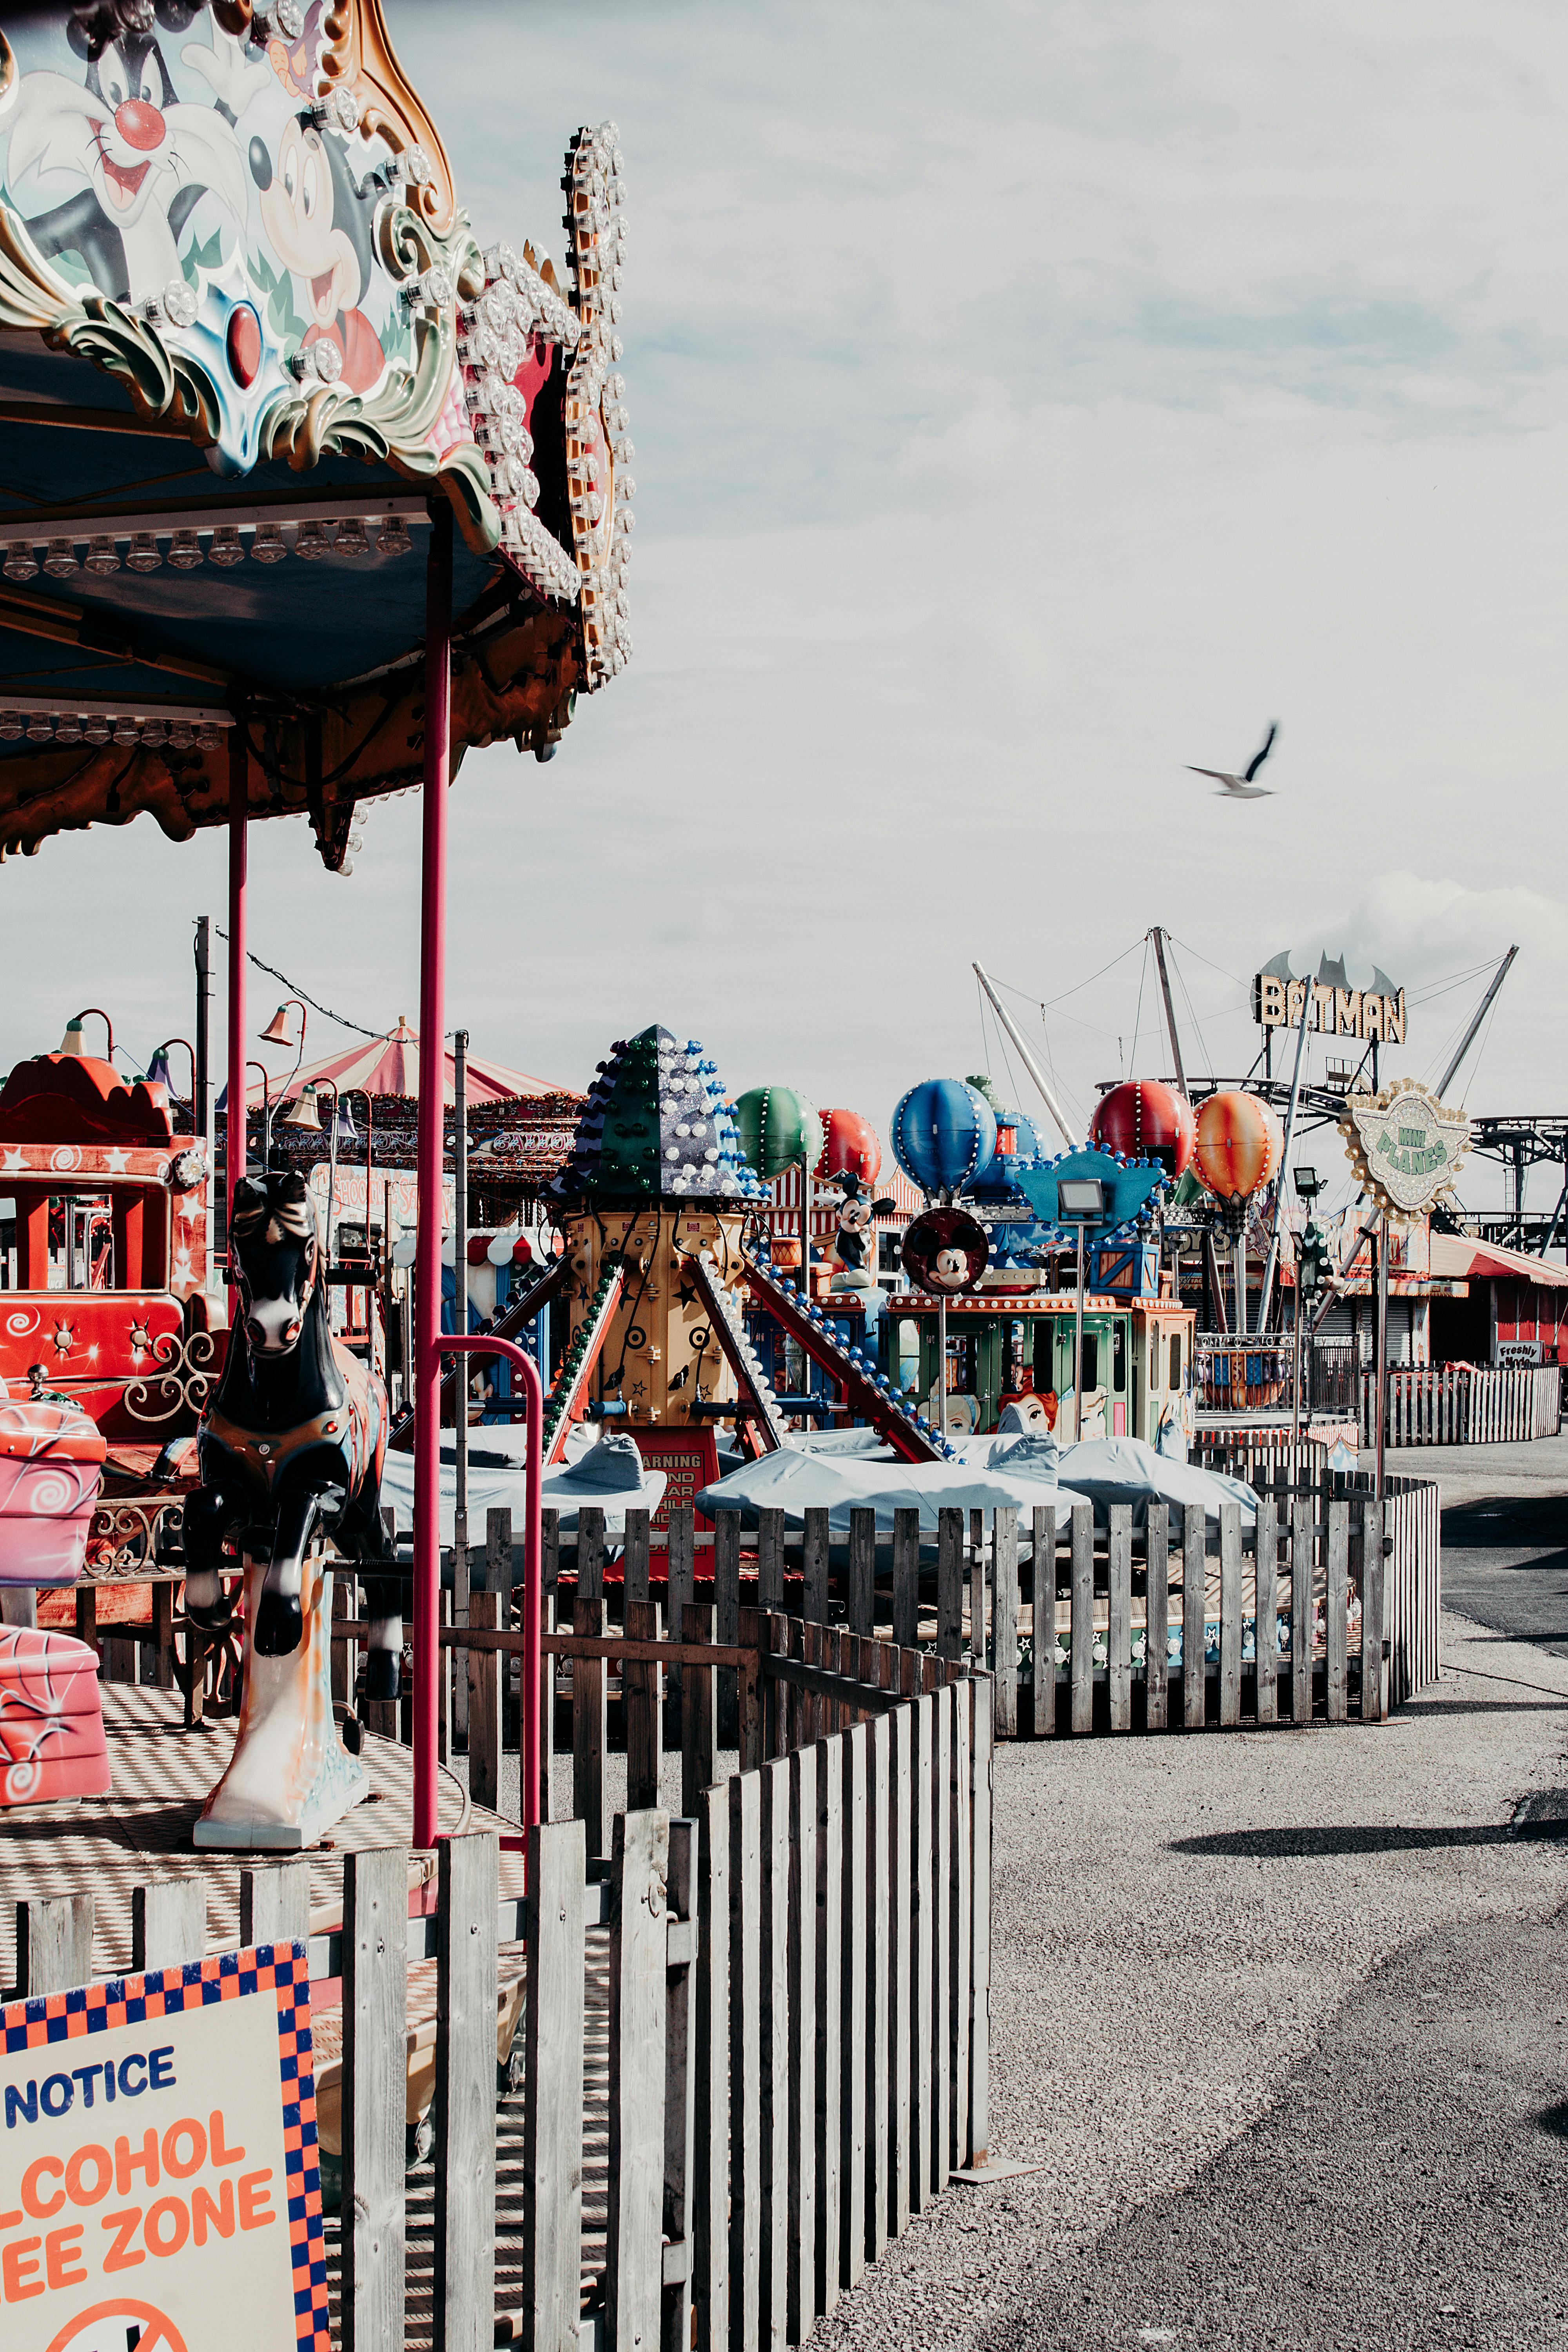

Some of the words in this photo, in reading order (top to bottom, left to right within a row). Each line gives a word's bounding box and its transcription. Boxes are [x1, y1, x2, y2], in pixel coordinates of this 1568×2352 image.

[1256, 975, 1405, 1044] BATMAN
[1376, 1130, 1447, 1175] PLANES
[1398, 1127, 1426, 1148] MINI
[1500, 1345, 1537, 1358] Freshly
[642, 1455, 701, 1468] ARNING
[4, 2045, 177, 2129] NOTICE
[0, 2223, 88, 2303] EE
[101, 2168, 276, 2274] ZONE
